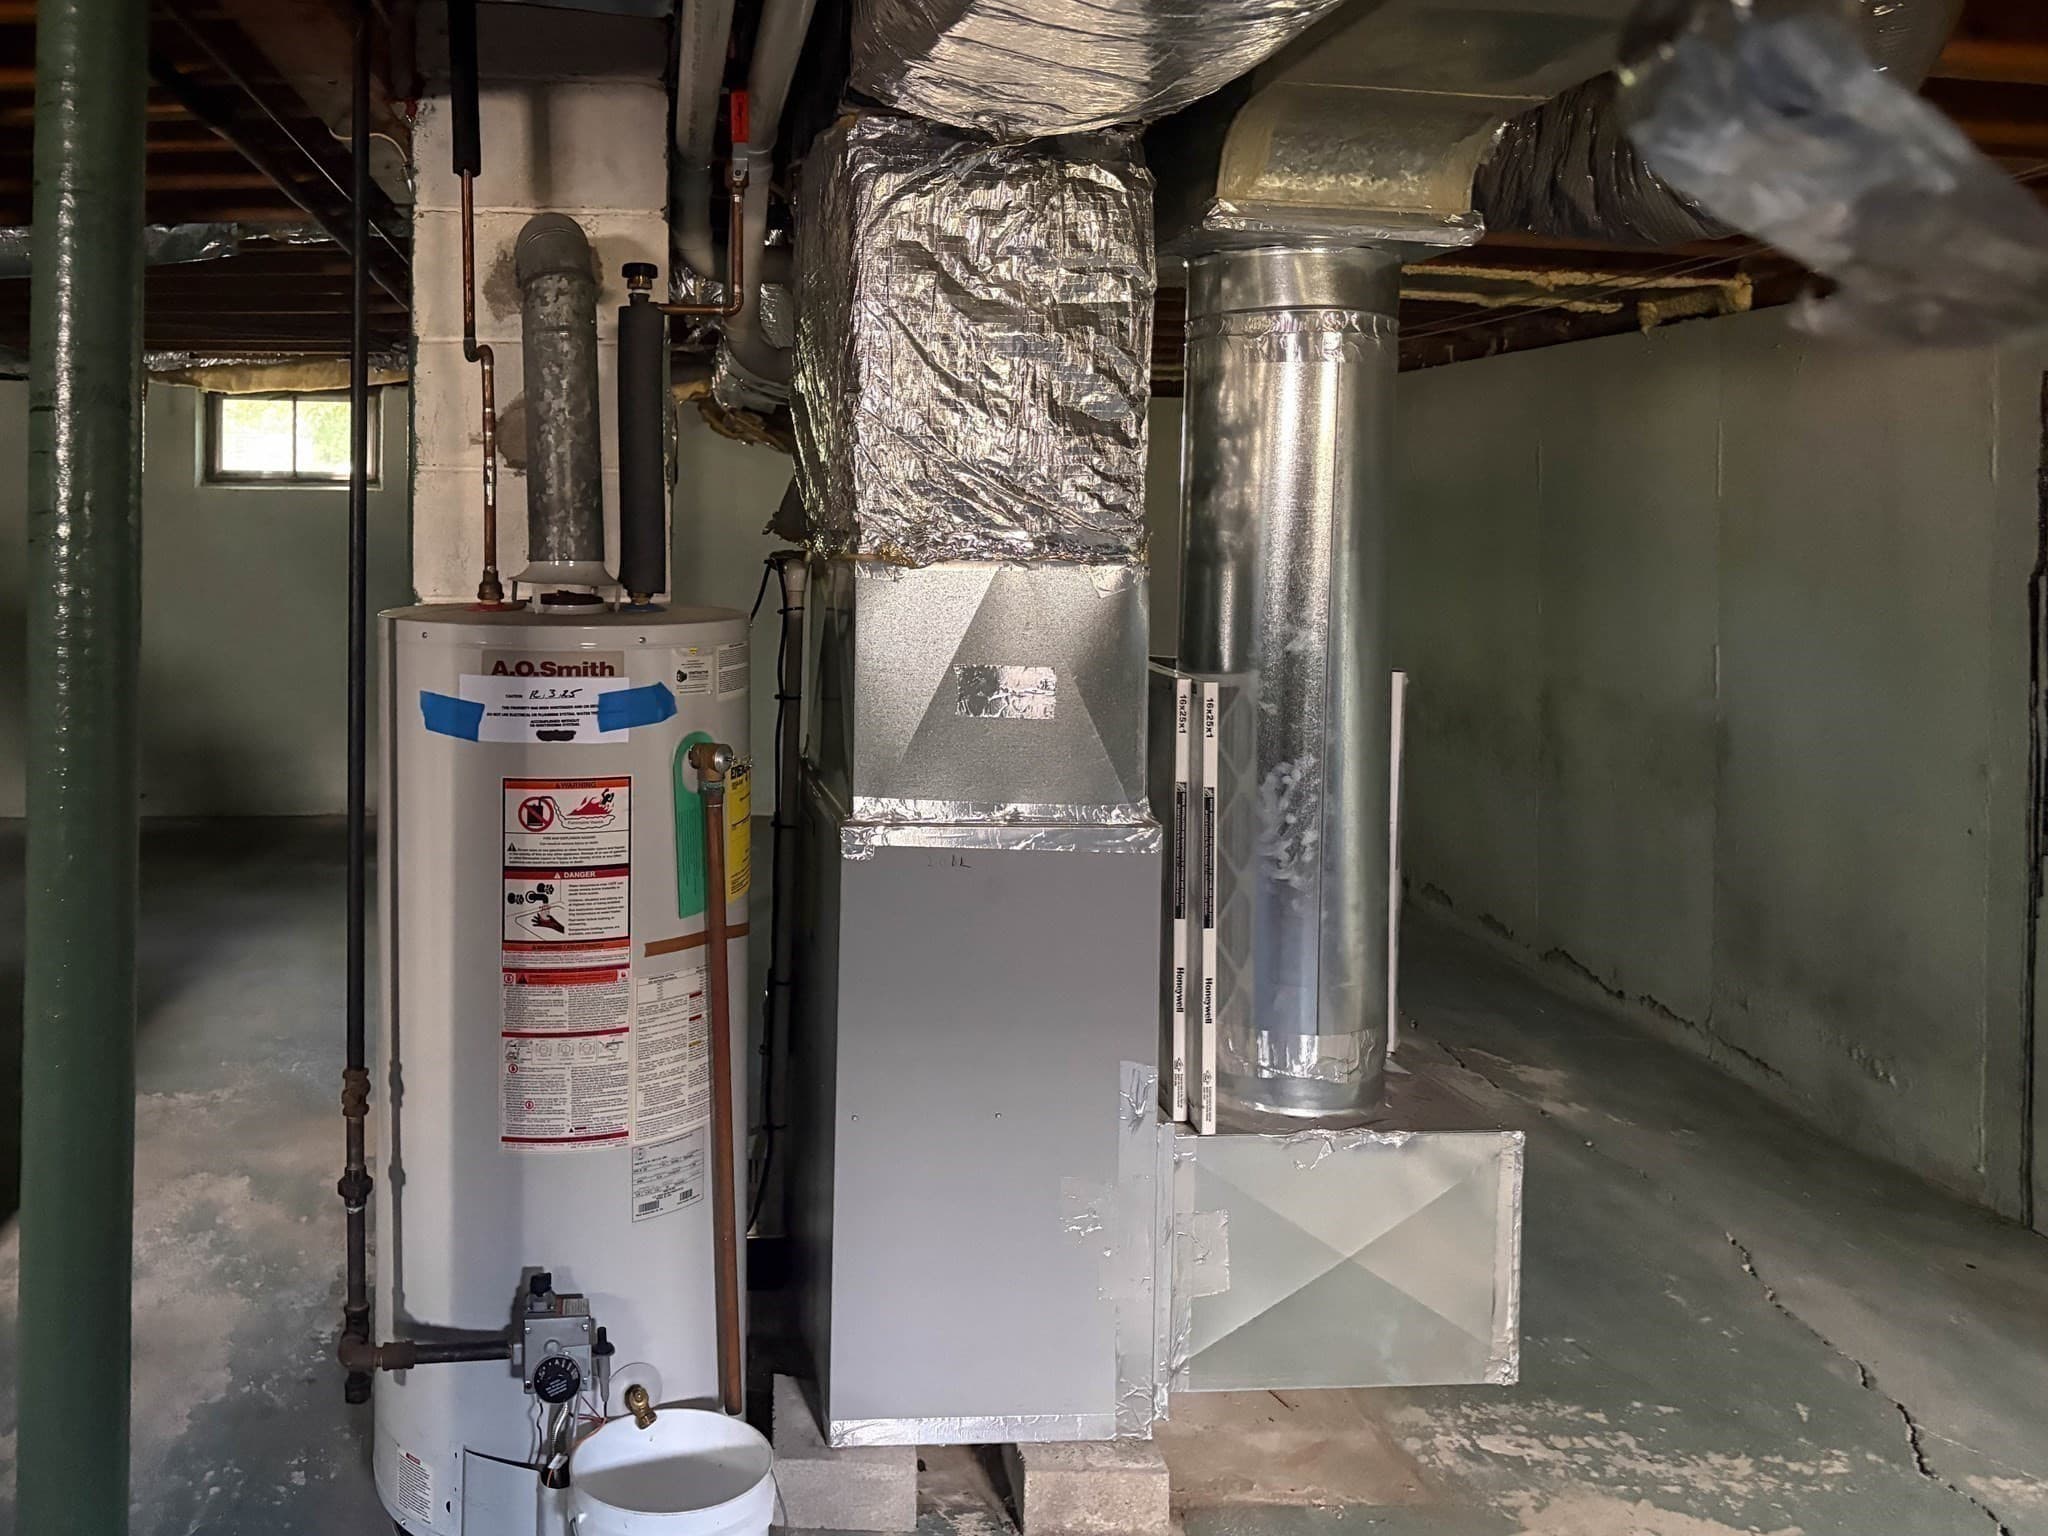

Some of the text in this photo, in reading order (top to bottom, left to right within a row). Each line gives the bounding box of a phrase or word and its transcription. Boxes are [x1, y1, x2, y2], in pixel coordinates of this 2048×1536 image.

[1179, 694, 1187, 734] 16x25x1
[1206, 697, 1214, 738] 16x25x1
[1175, 967, 1184, 1013] Honeywell
[1203, 977, 1213, 1024] Honeywell
